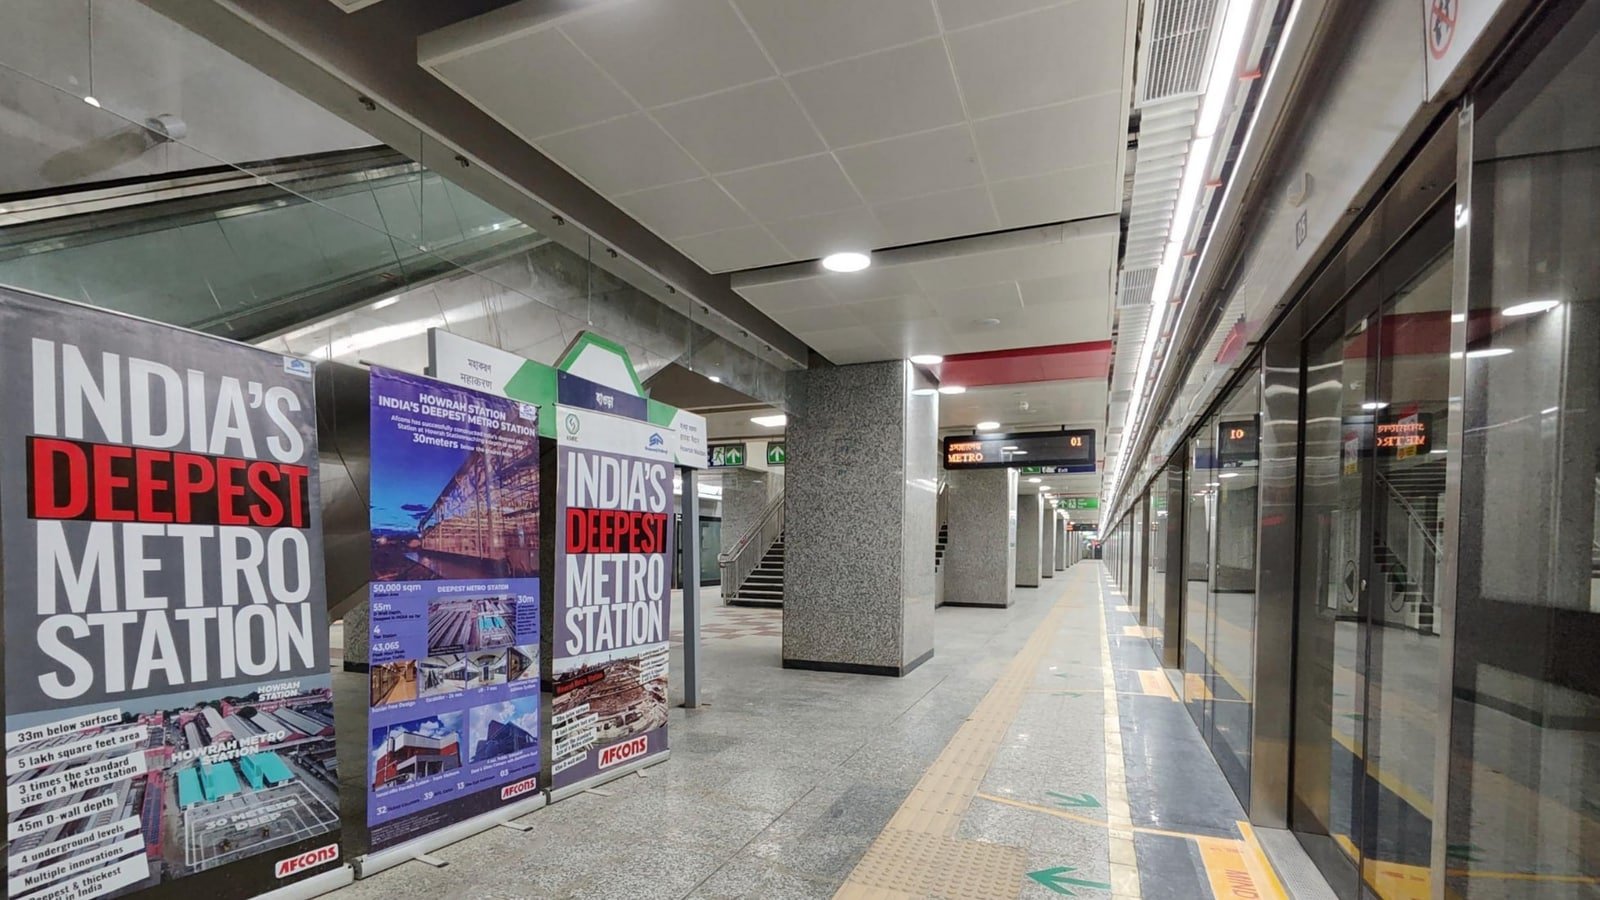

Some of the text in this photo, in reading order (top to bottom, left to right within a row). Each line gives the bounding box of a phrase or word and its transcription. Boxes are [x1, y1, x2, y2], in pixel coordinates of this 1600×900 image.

[461, 373, 492, 390] महाकरण
[32, 338, 304, 464] INDIA'S
[420, 393, 467, 412] HOWRAH
[469, 404, 506, 420] STATION
[379, 396, 535, 437] INDIA'S DEEPEST METRO STATION
[413, 433, 458, 448] 30meters
[1070, 437, 1081, 446] 01
[948, 453, 983, 462] METRO
[33, 438, 308, 527] DEEPEST
[567, 452, 666, 513] INDIA'S
[566, 509, 666, 553] DEEPEST
[36, 520, 311, 615] METRO
[566, 553, 664, 608] METRO
[373, 584, 421, 593] 50,000 sqm
[517, 595, 534, 603] 30m
[374, 625, 380, 633] 4
[566, 600, 662, 656] STATION
[36, 602, 314, 699] STATION
[258, 681, 300, 694] HOWRAH
[259, 690, 298, 702] STATION
[18, 713, 118, 742] 33m below surface
[19, 732, 140, 768] 5 lakh square feet area
[172, 730, 286, 762] HOWRAH METRO
[201, 745, 259, 765] STATION
[600, 738, 645, 766] AFCONS
[19, 758, 129, 795] 3 times the standard
[21, 792, 42, 805] size
[47, 787, 58, 797] of
[70, 776, 100, 791] Metro
[104, 766, 137, 780] station
[503, 780, 534, 798] AFCONS
[17, 798, 114, 833] 45m D-wall depth
[205, 818, 228, 830] 30
[235, 812, 281, 831] DEEP
[376, 806, 387, 815] 32
[32, 832, 95, 861] underground
[98, 825, 124, 839] levels
[24, 846, 123, 886] Multiple innovations
[279, 845, 336, 875] AFCONS
[73, 882, 79, 890] &
[82, 868, 121, 886] thickest
[78, 884, 102, 897] India
[1224, 869, 1259, 899] MIND
